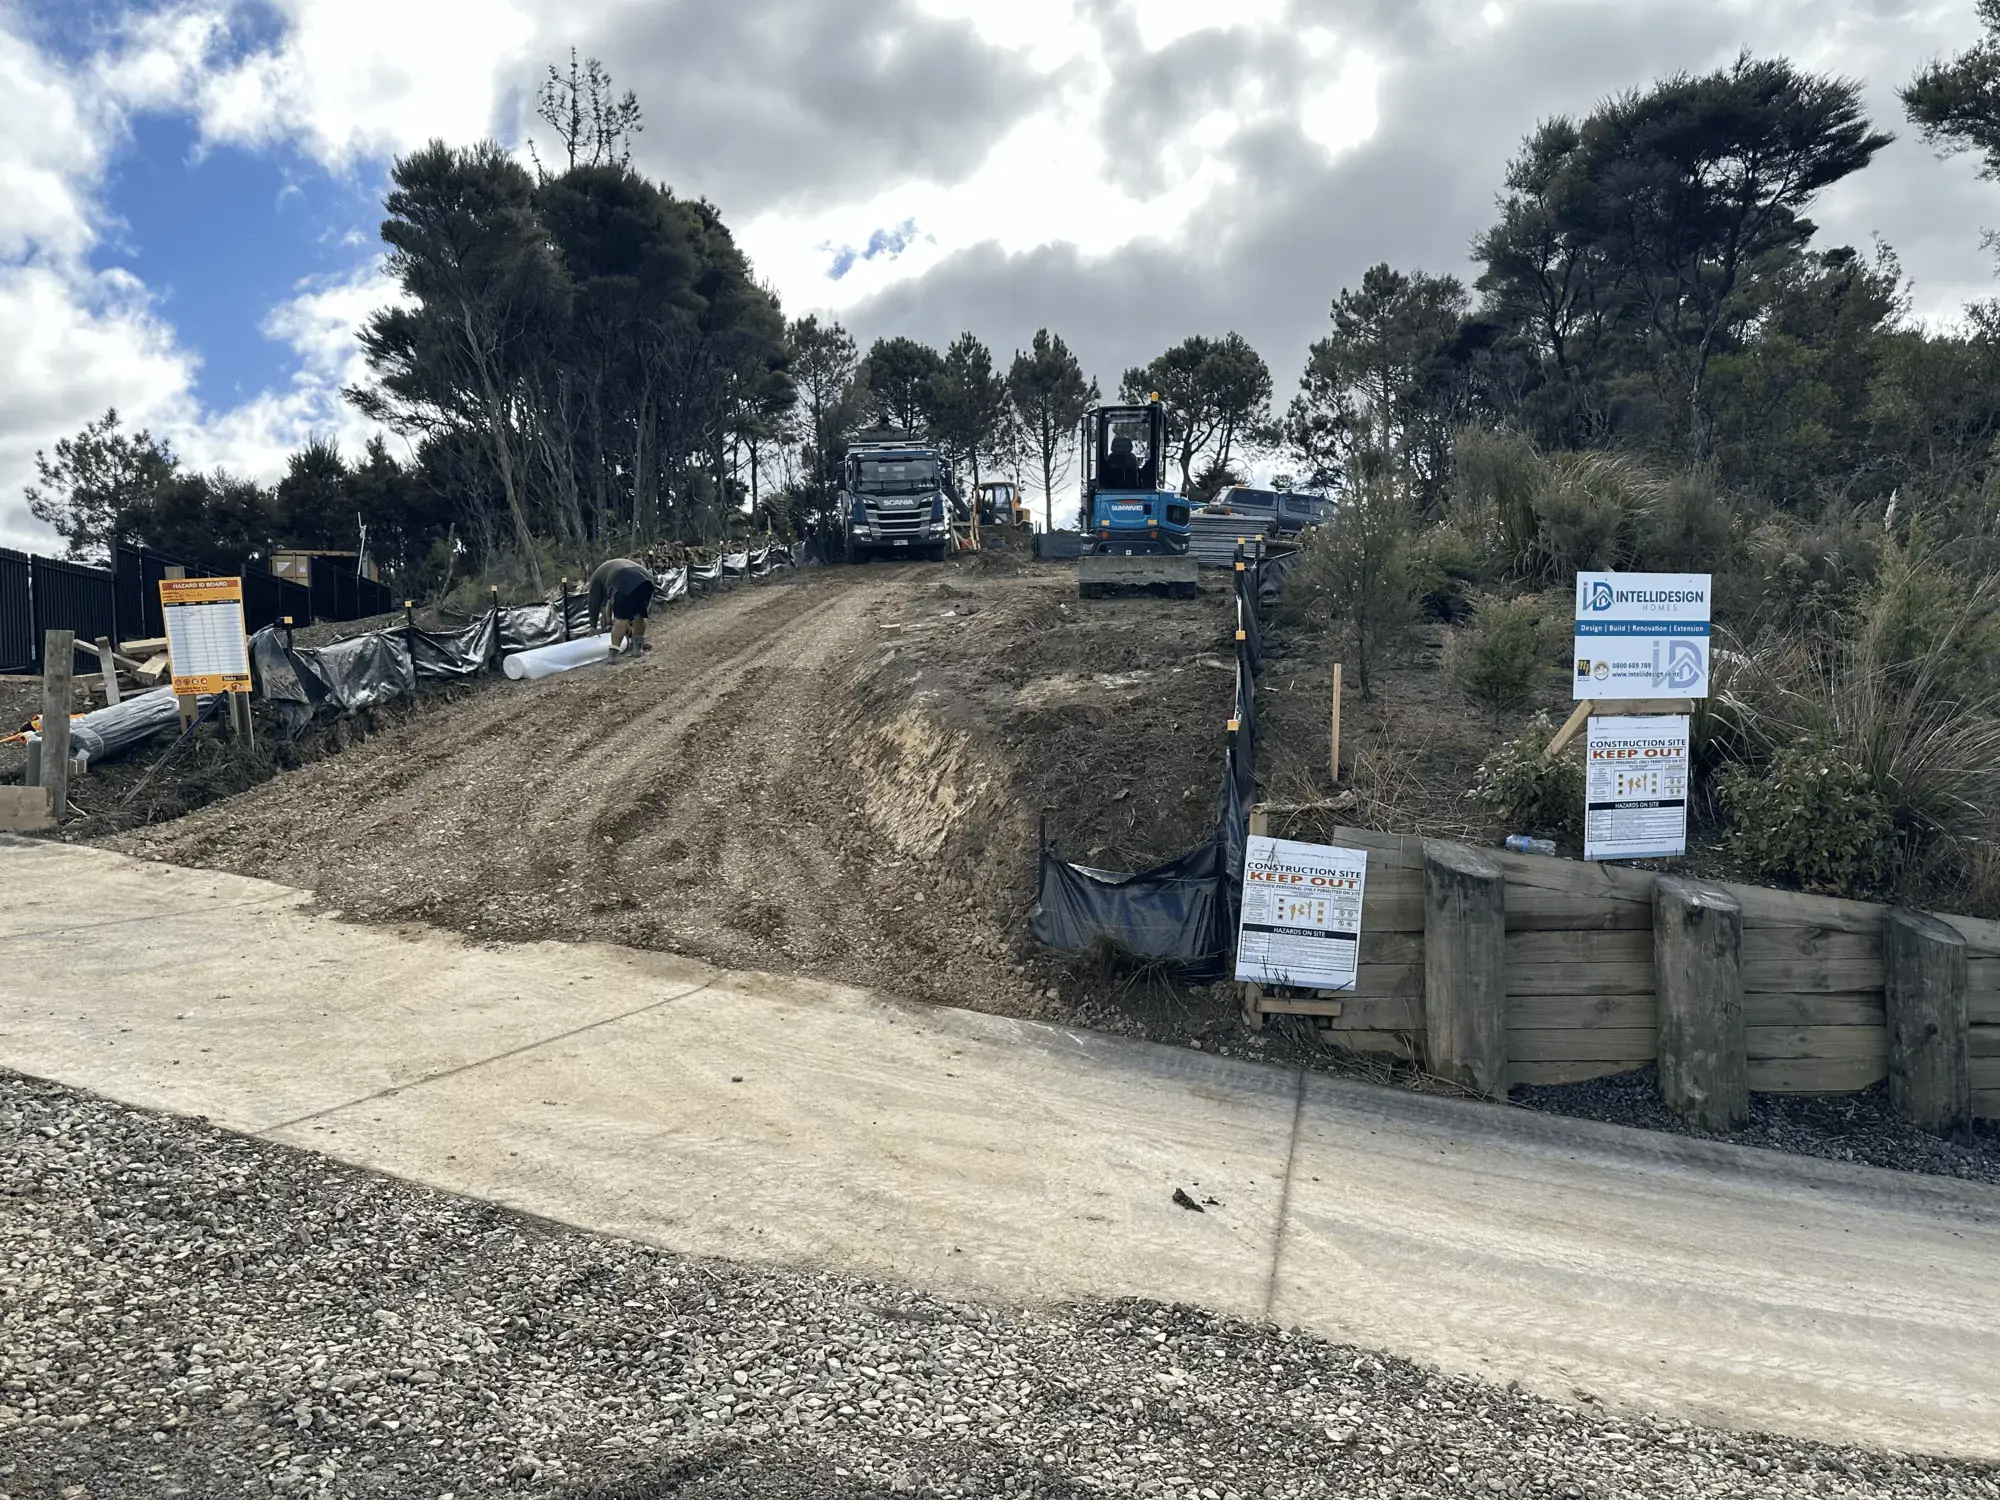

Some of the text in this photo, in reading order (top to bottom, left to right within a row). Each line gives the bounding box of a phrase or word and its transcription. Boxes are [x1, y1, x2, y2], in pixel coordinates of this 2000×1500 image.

[1616, 590, 1704, 603] INTELLIDESIGN
[1581, 625, 1602, 633] Design
[1590, 740, 1665, 748] CONSTRUCTION
[1593, 748, 1683, 759] KEEP OUT
[1247, 861, 1362, 879] CONSTRUCTION SITE
[1250, 871, 1358, 889] KEEP OUT
[1274, 927, 1302, 935] HAZARDS
